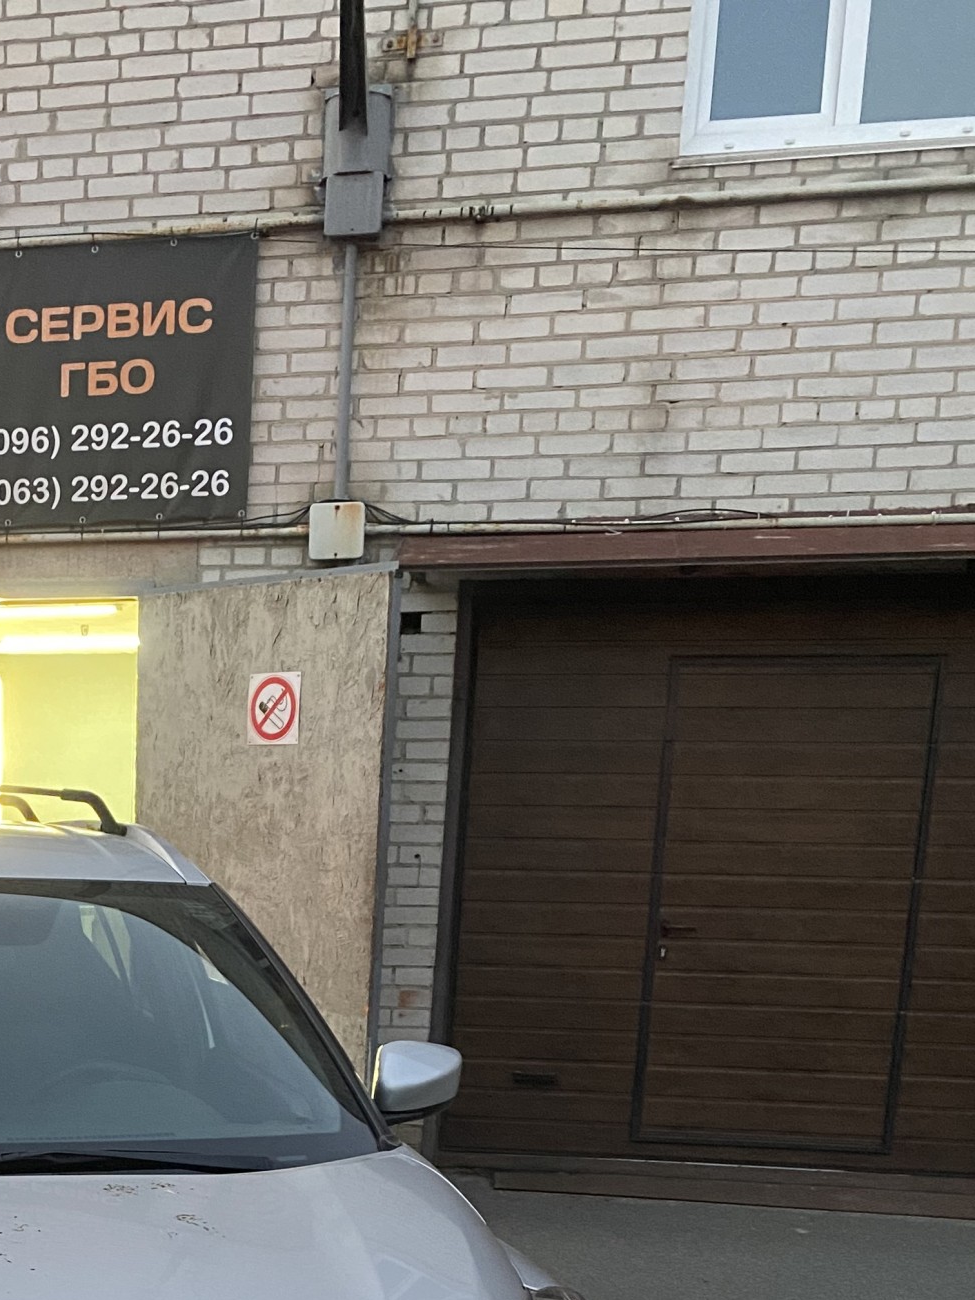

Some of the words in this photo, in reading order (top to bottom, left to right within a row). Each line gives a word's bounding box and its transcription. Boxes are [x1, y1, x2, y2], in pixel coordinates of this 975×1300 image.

[5, 298, 213, 344] СЕРВИС
[60, 358, 155, 398] ГБО
[71, 418, 234, 452] 292-26-26
[71, 469, 230, 502] 292-26-26
